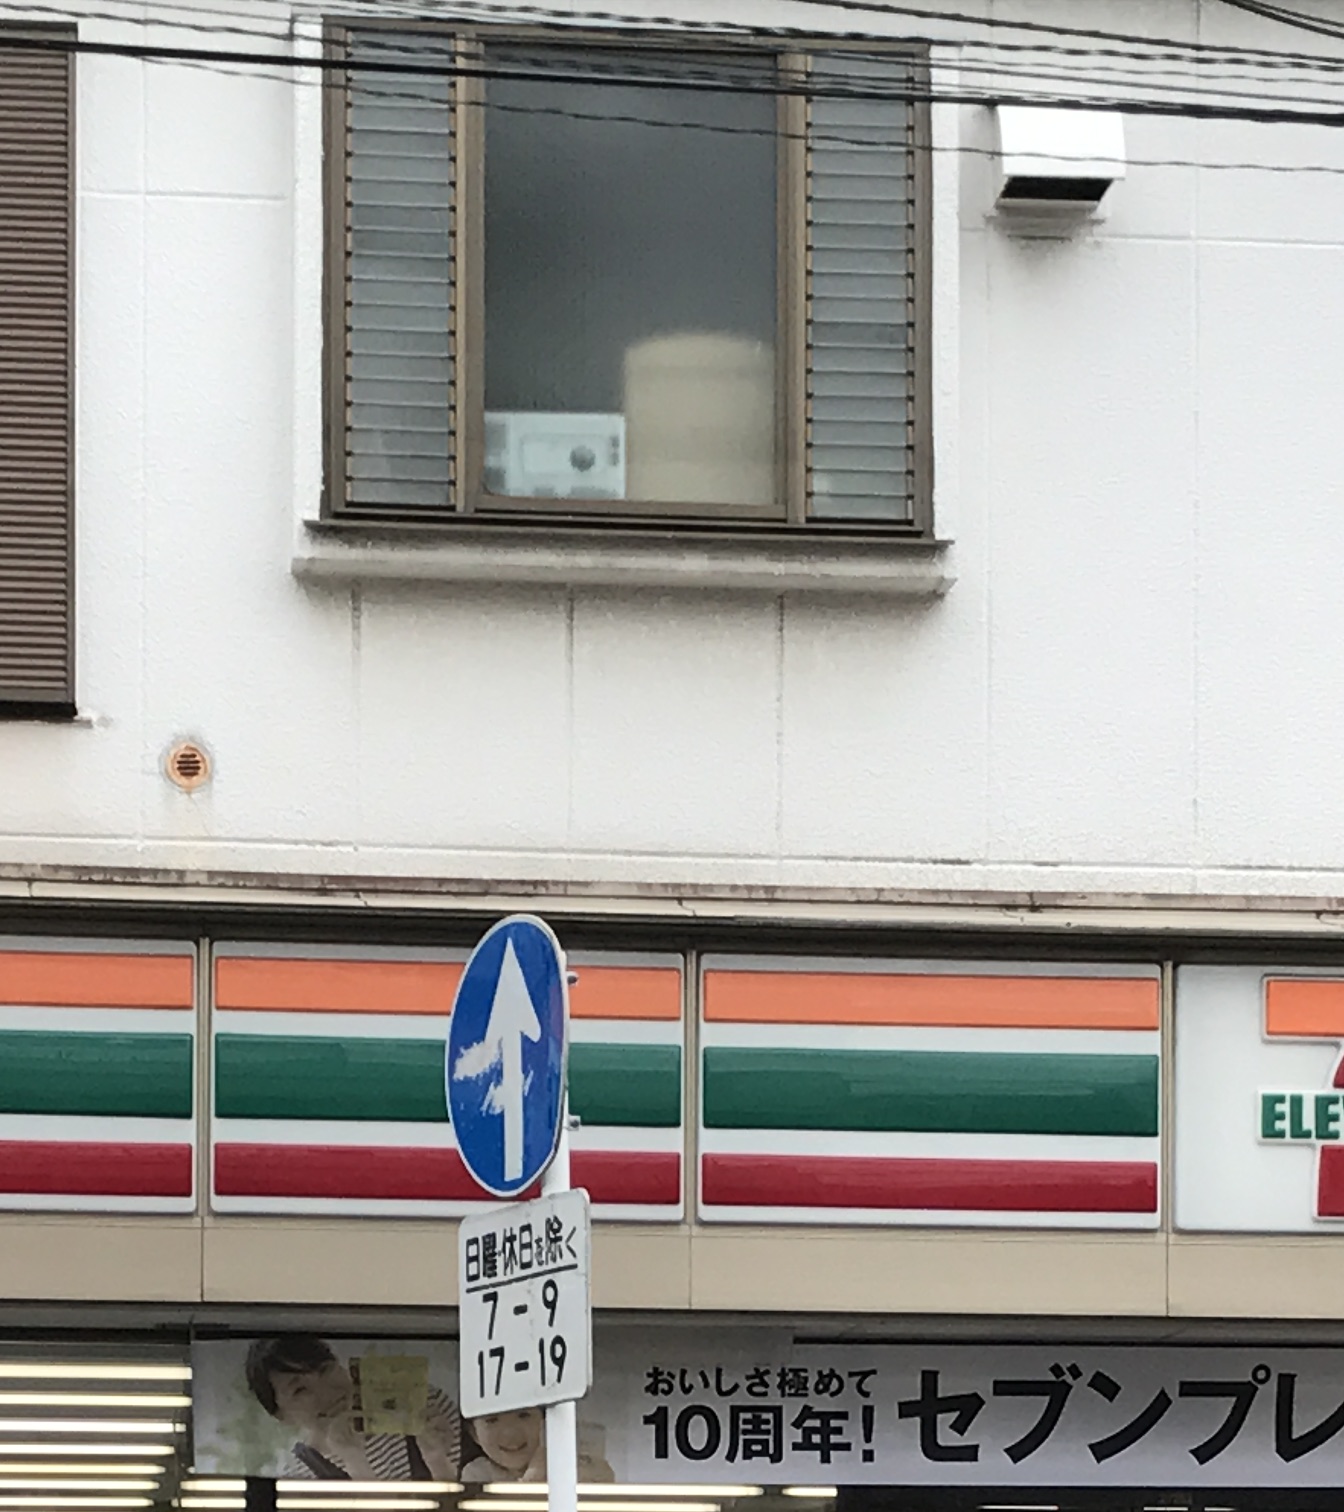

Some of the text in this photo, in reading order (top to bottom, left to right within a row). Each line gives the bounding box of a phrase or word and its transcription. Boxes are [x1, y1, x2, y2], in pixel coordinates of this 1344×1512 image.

[643, 1366, 878, 1399] おいしさ極めて
